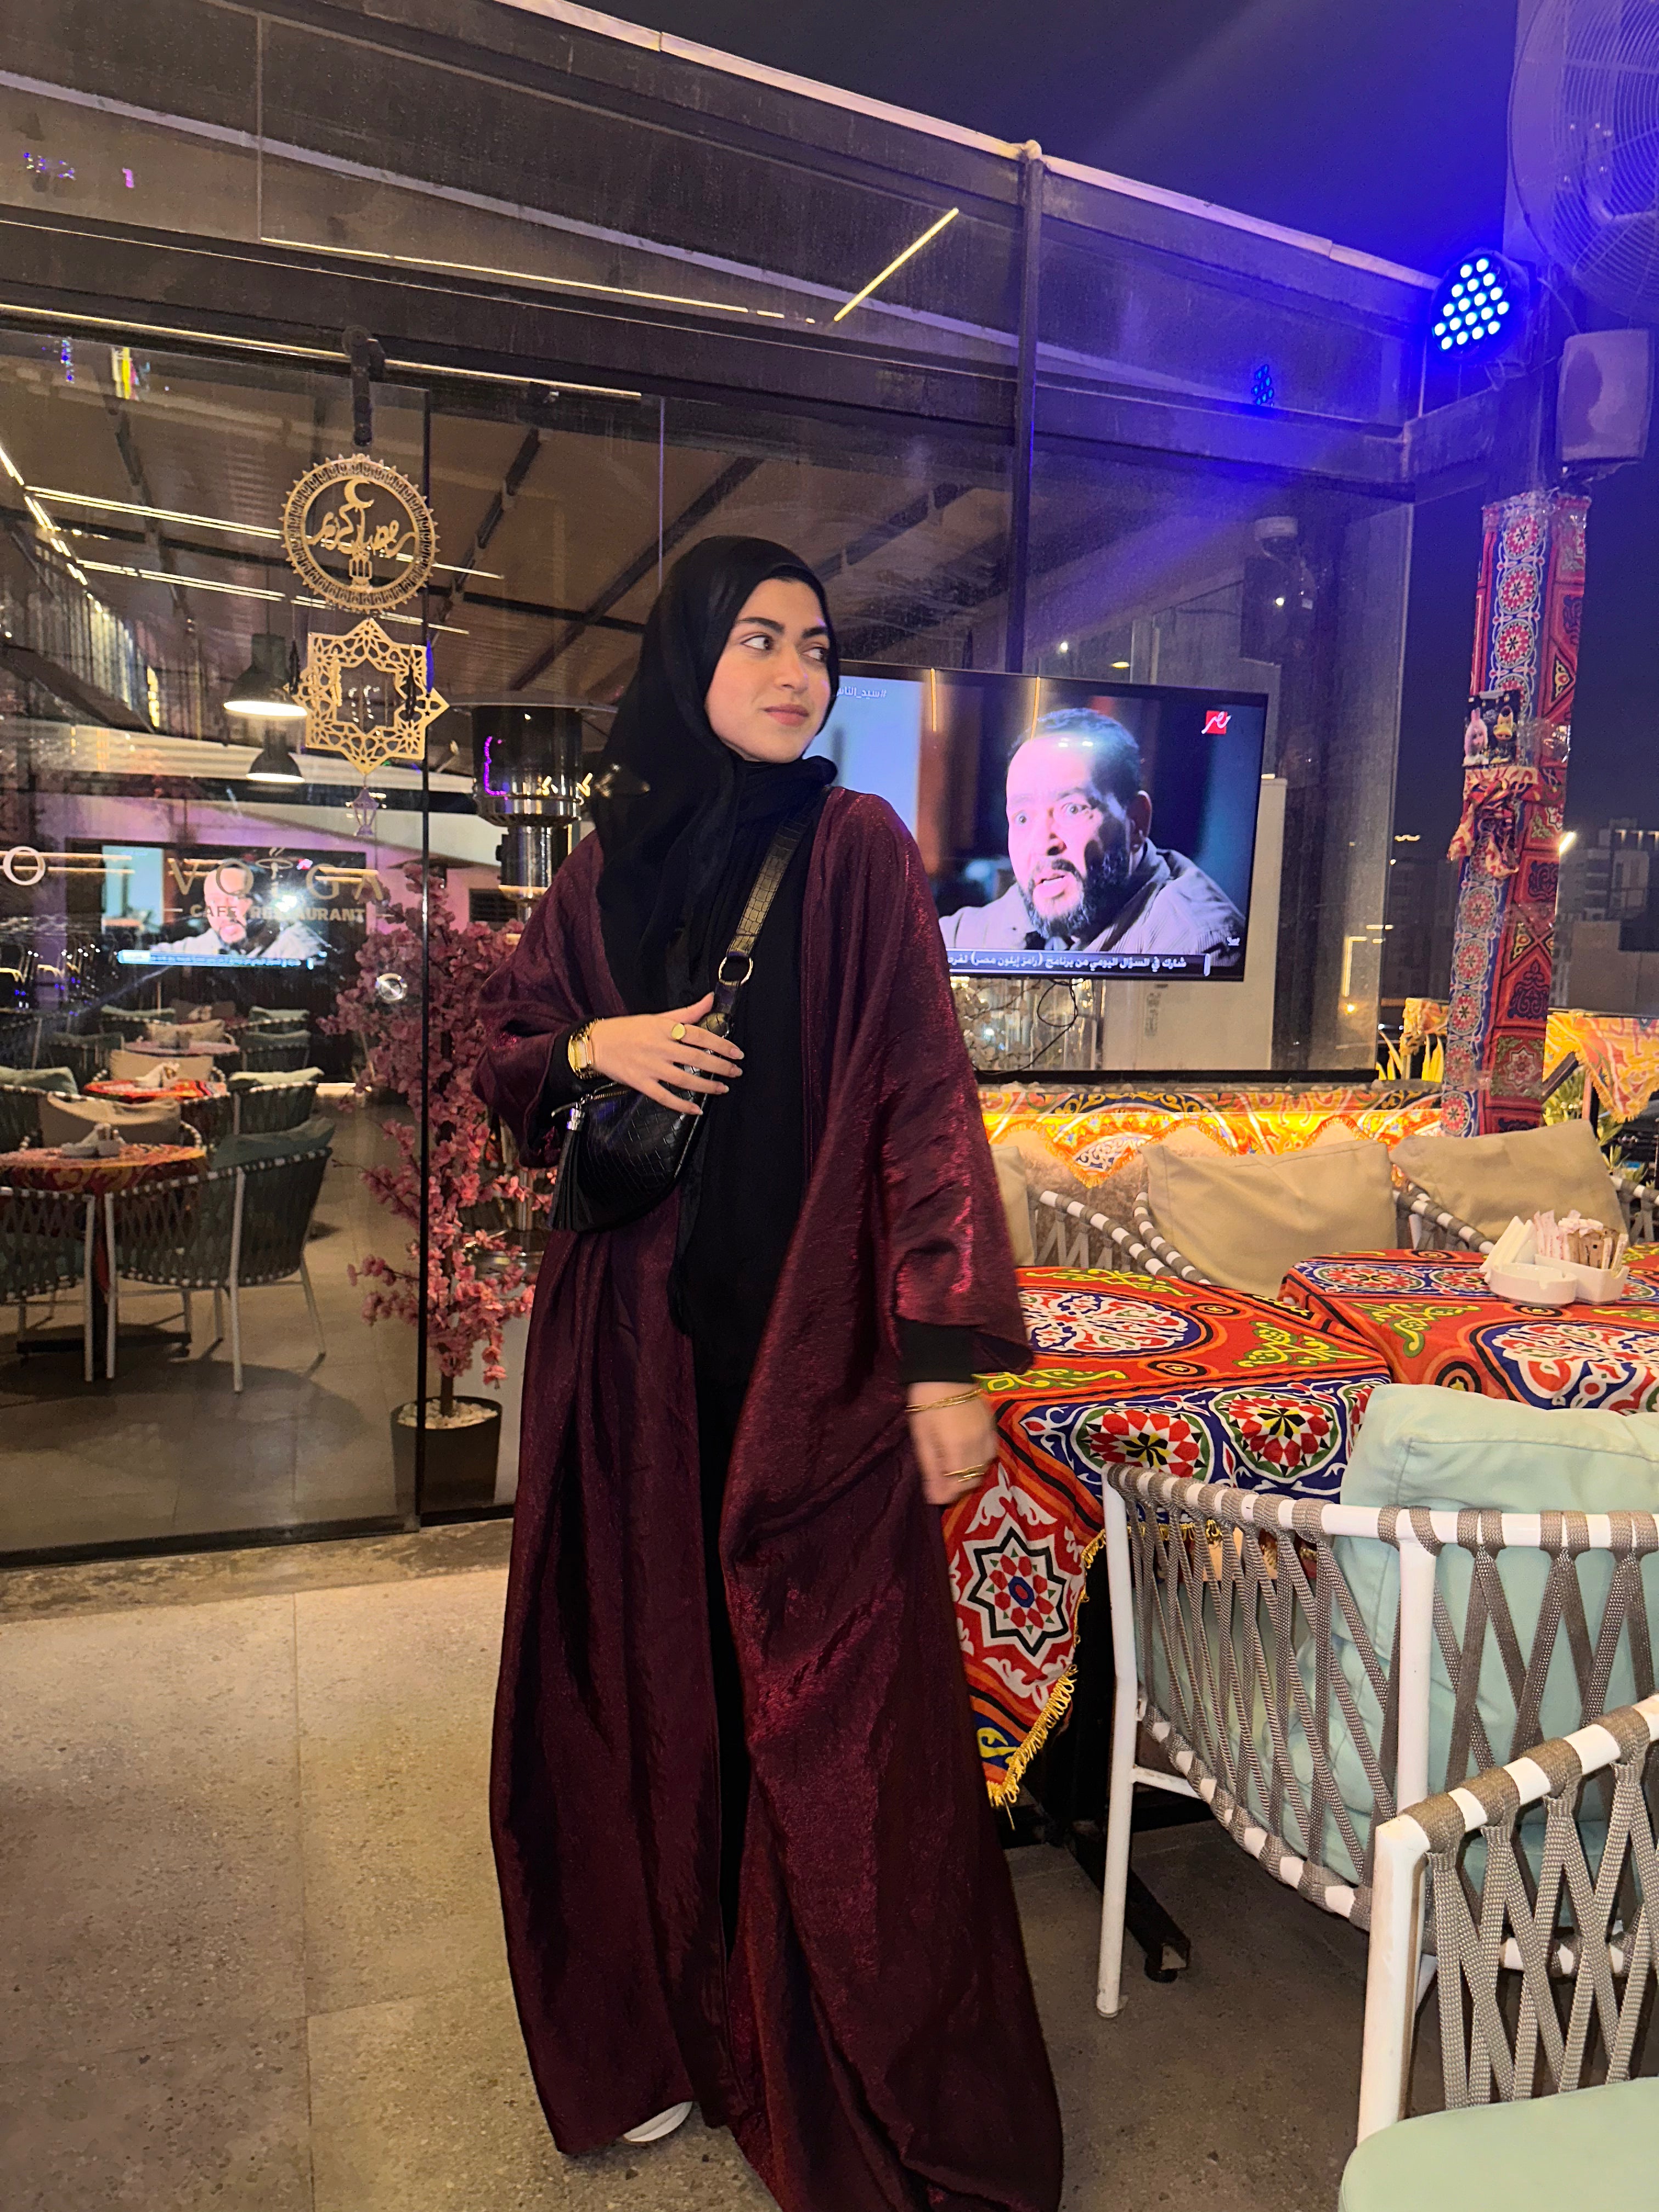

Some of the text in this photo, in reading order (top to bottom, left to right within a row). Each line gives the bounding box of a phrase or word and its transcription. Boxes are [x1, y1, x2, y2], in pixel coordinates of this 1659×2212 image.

[250, 906, 366, 923] REAURANT
[1045, 956, 1074, 969] برنامج
[1075, 958, 1089, 968] من
[1089, 957, 1119, 972] اليومي
[1119, 957, 1150, 969] السؤال
[1151, 956, 1160, 973] في
[1162, 957, 1187, 969] شارك
